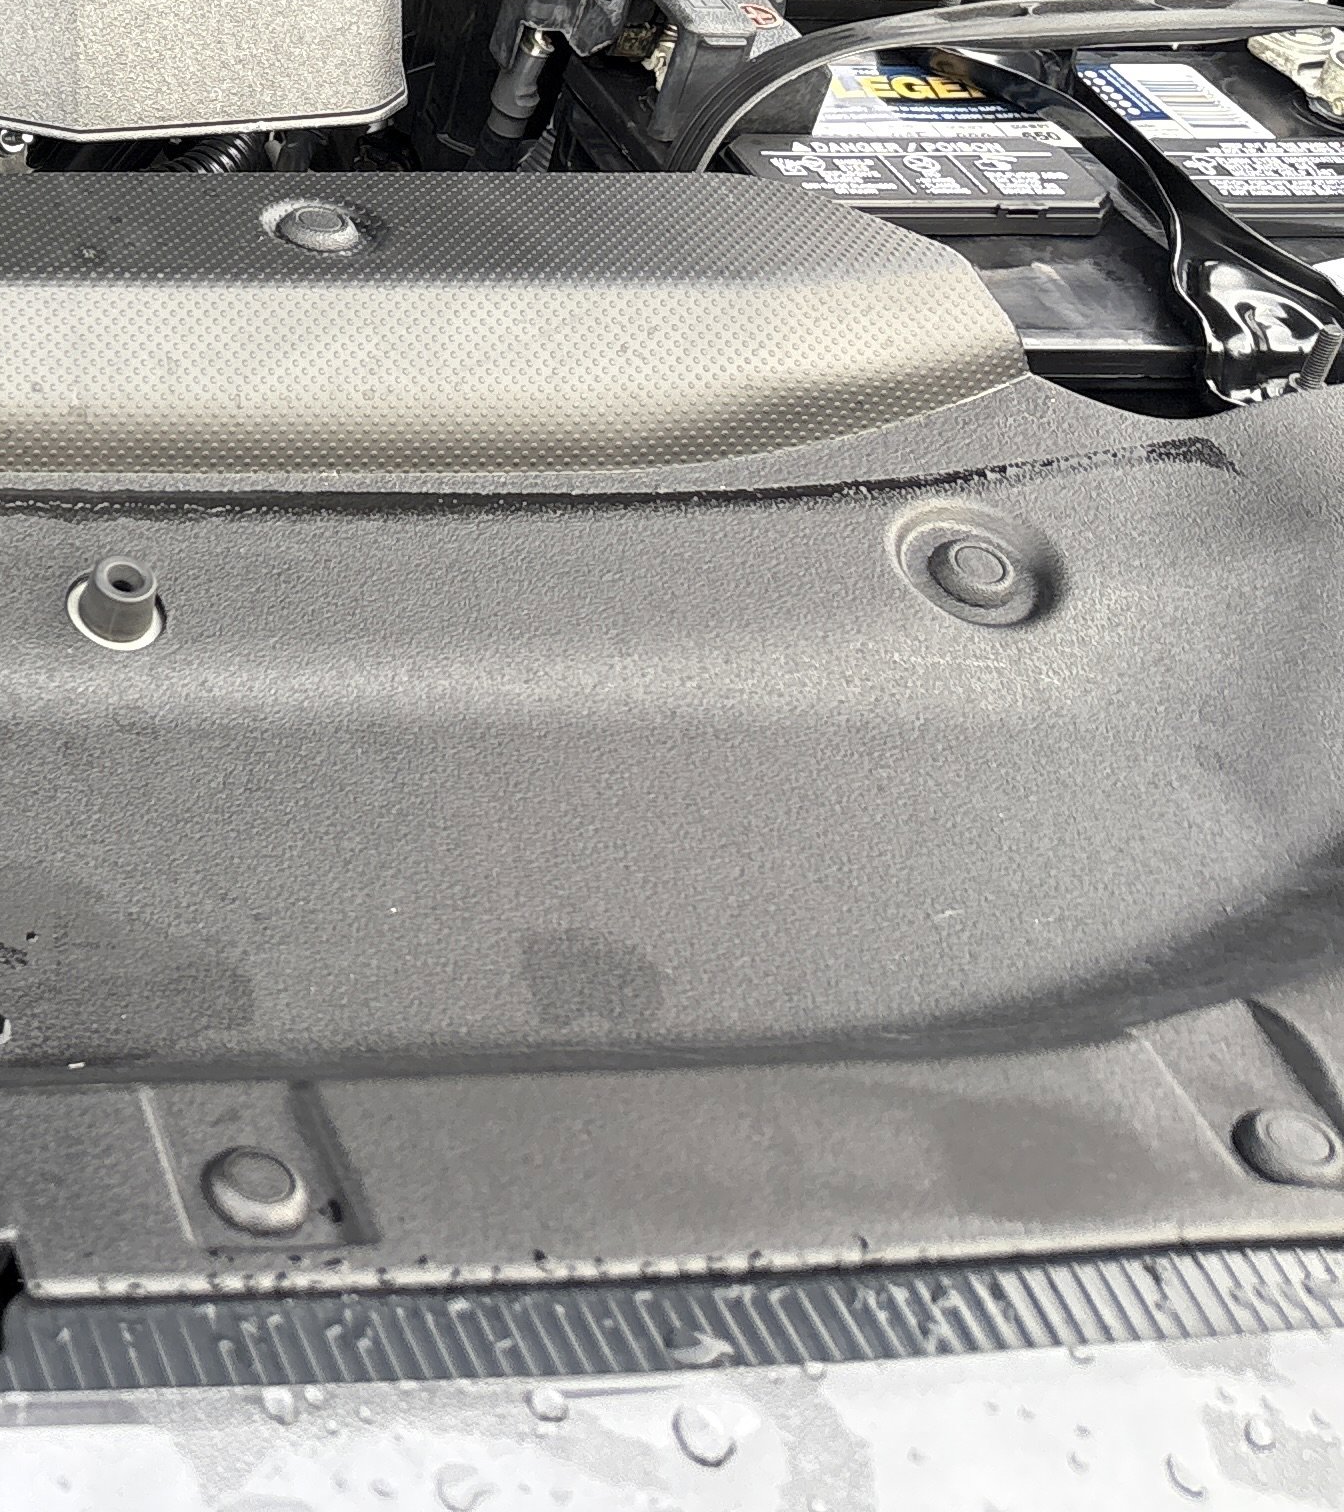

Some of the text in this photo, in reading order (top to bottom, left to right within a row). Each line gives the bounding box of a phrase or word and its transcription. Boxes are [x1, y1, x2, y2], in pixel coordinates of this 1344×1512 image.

[830, 74, 987, 100] LEGE
[812, 141, 903, 153] DANGER
[923, 141, 1006, 153] POISON
